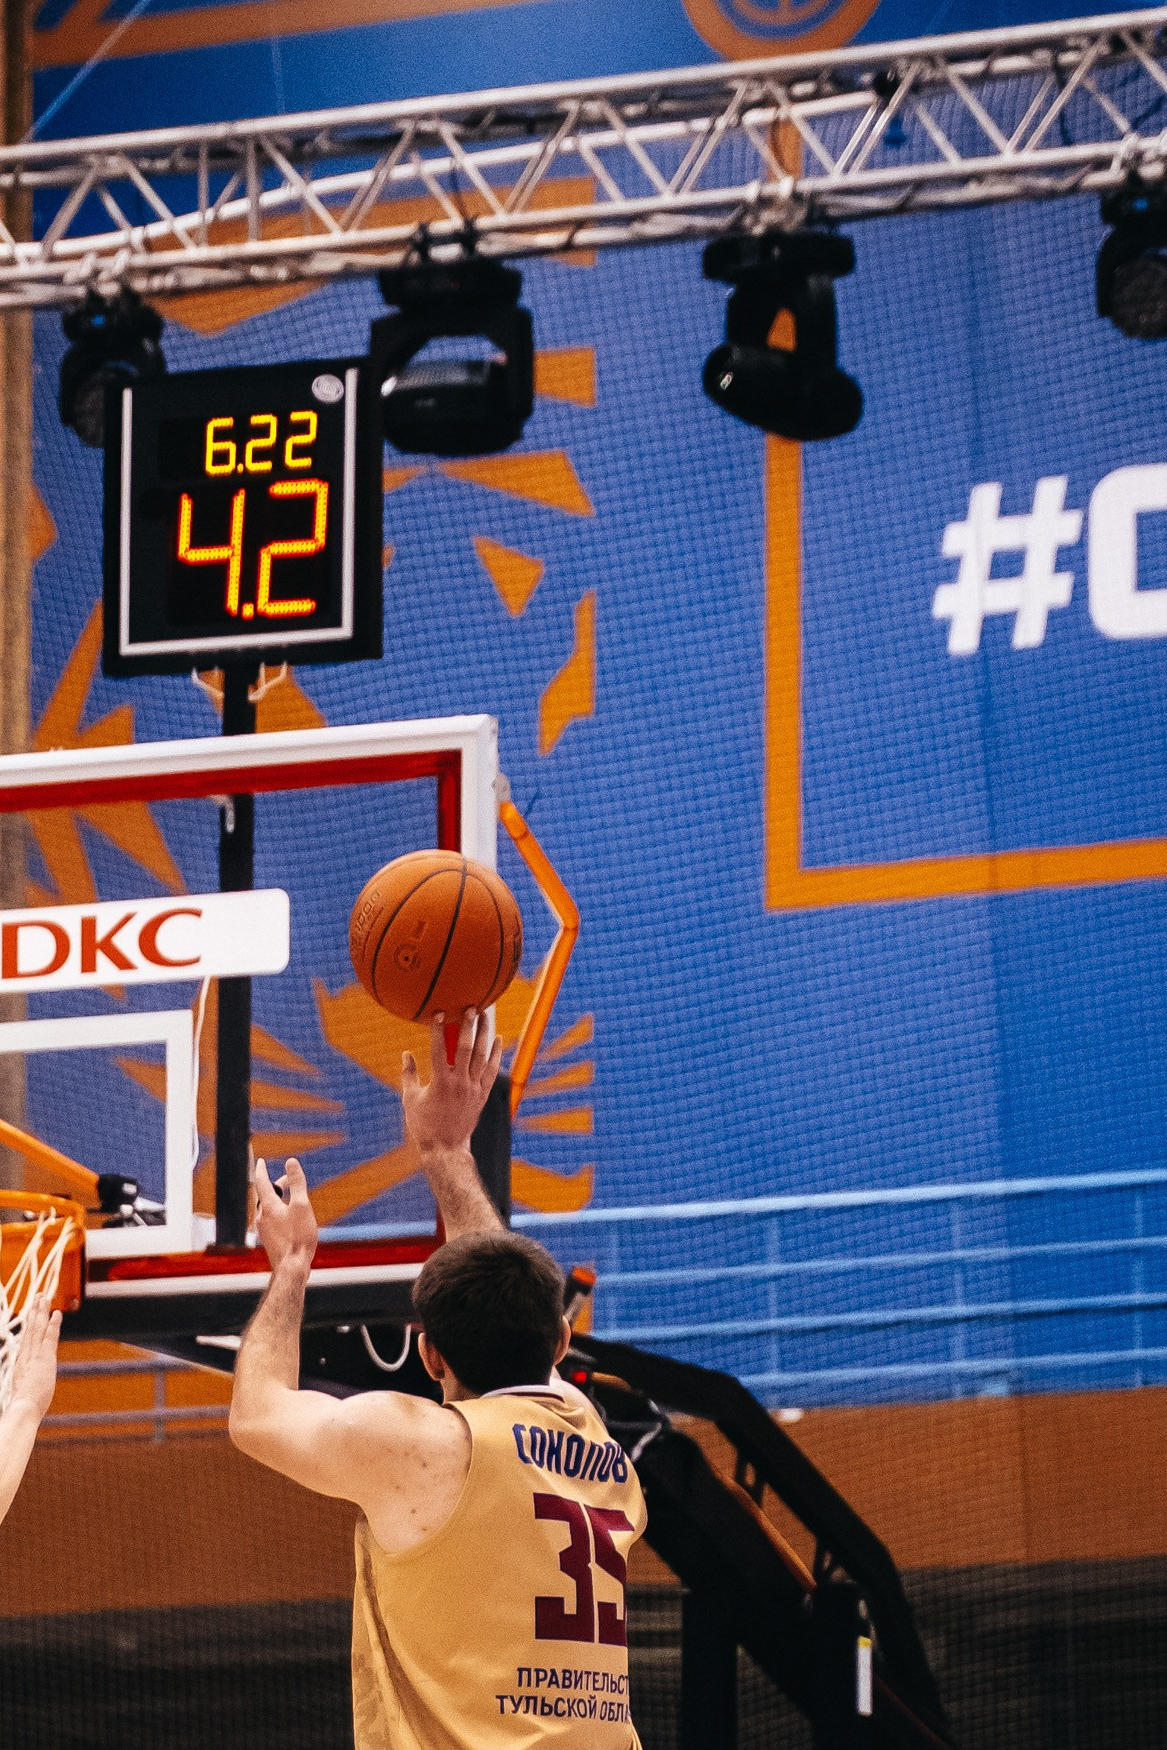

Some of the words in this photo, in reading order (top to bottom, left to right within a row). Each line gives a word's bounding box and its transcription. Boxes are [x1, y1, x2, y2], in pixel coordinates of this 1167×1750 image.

[205, 410, 318, 476] 6.22
[178, 478, 329, 619] 4.2
[0, 907, 202, 980] DKC
[512, 1422, 628, 1484] СОКОЛОВ
[532, 1491, 635, 1648] 35
[495, 1694, 597, 1719] ТУЛЬСКОЙ
